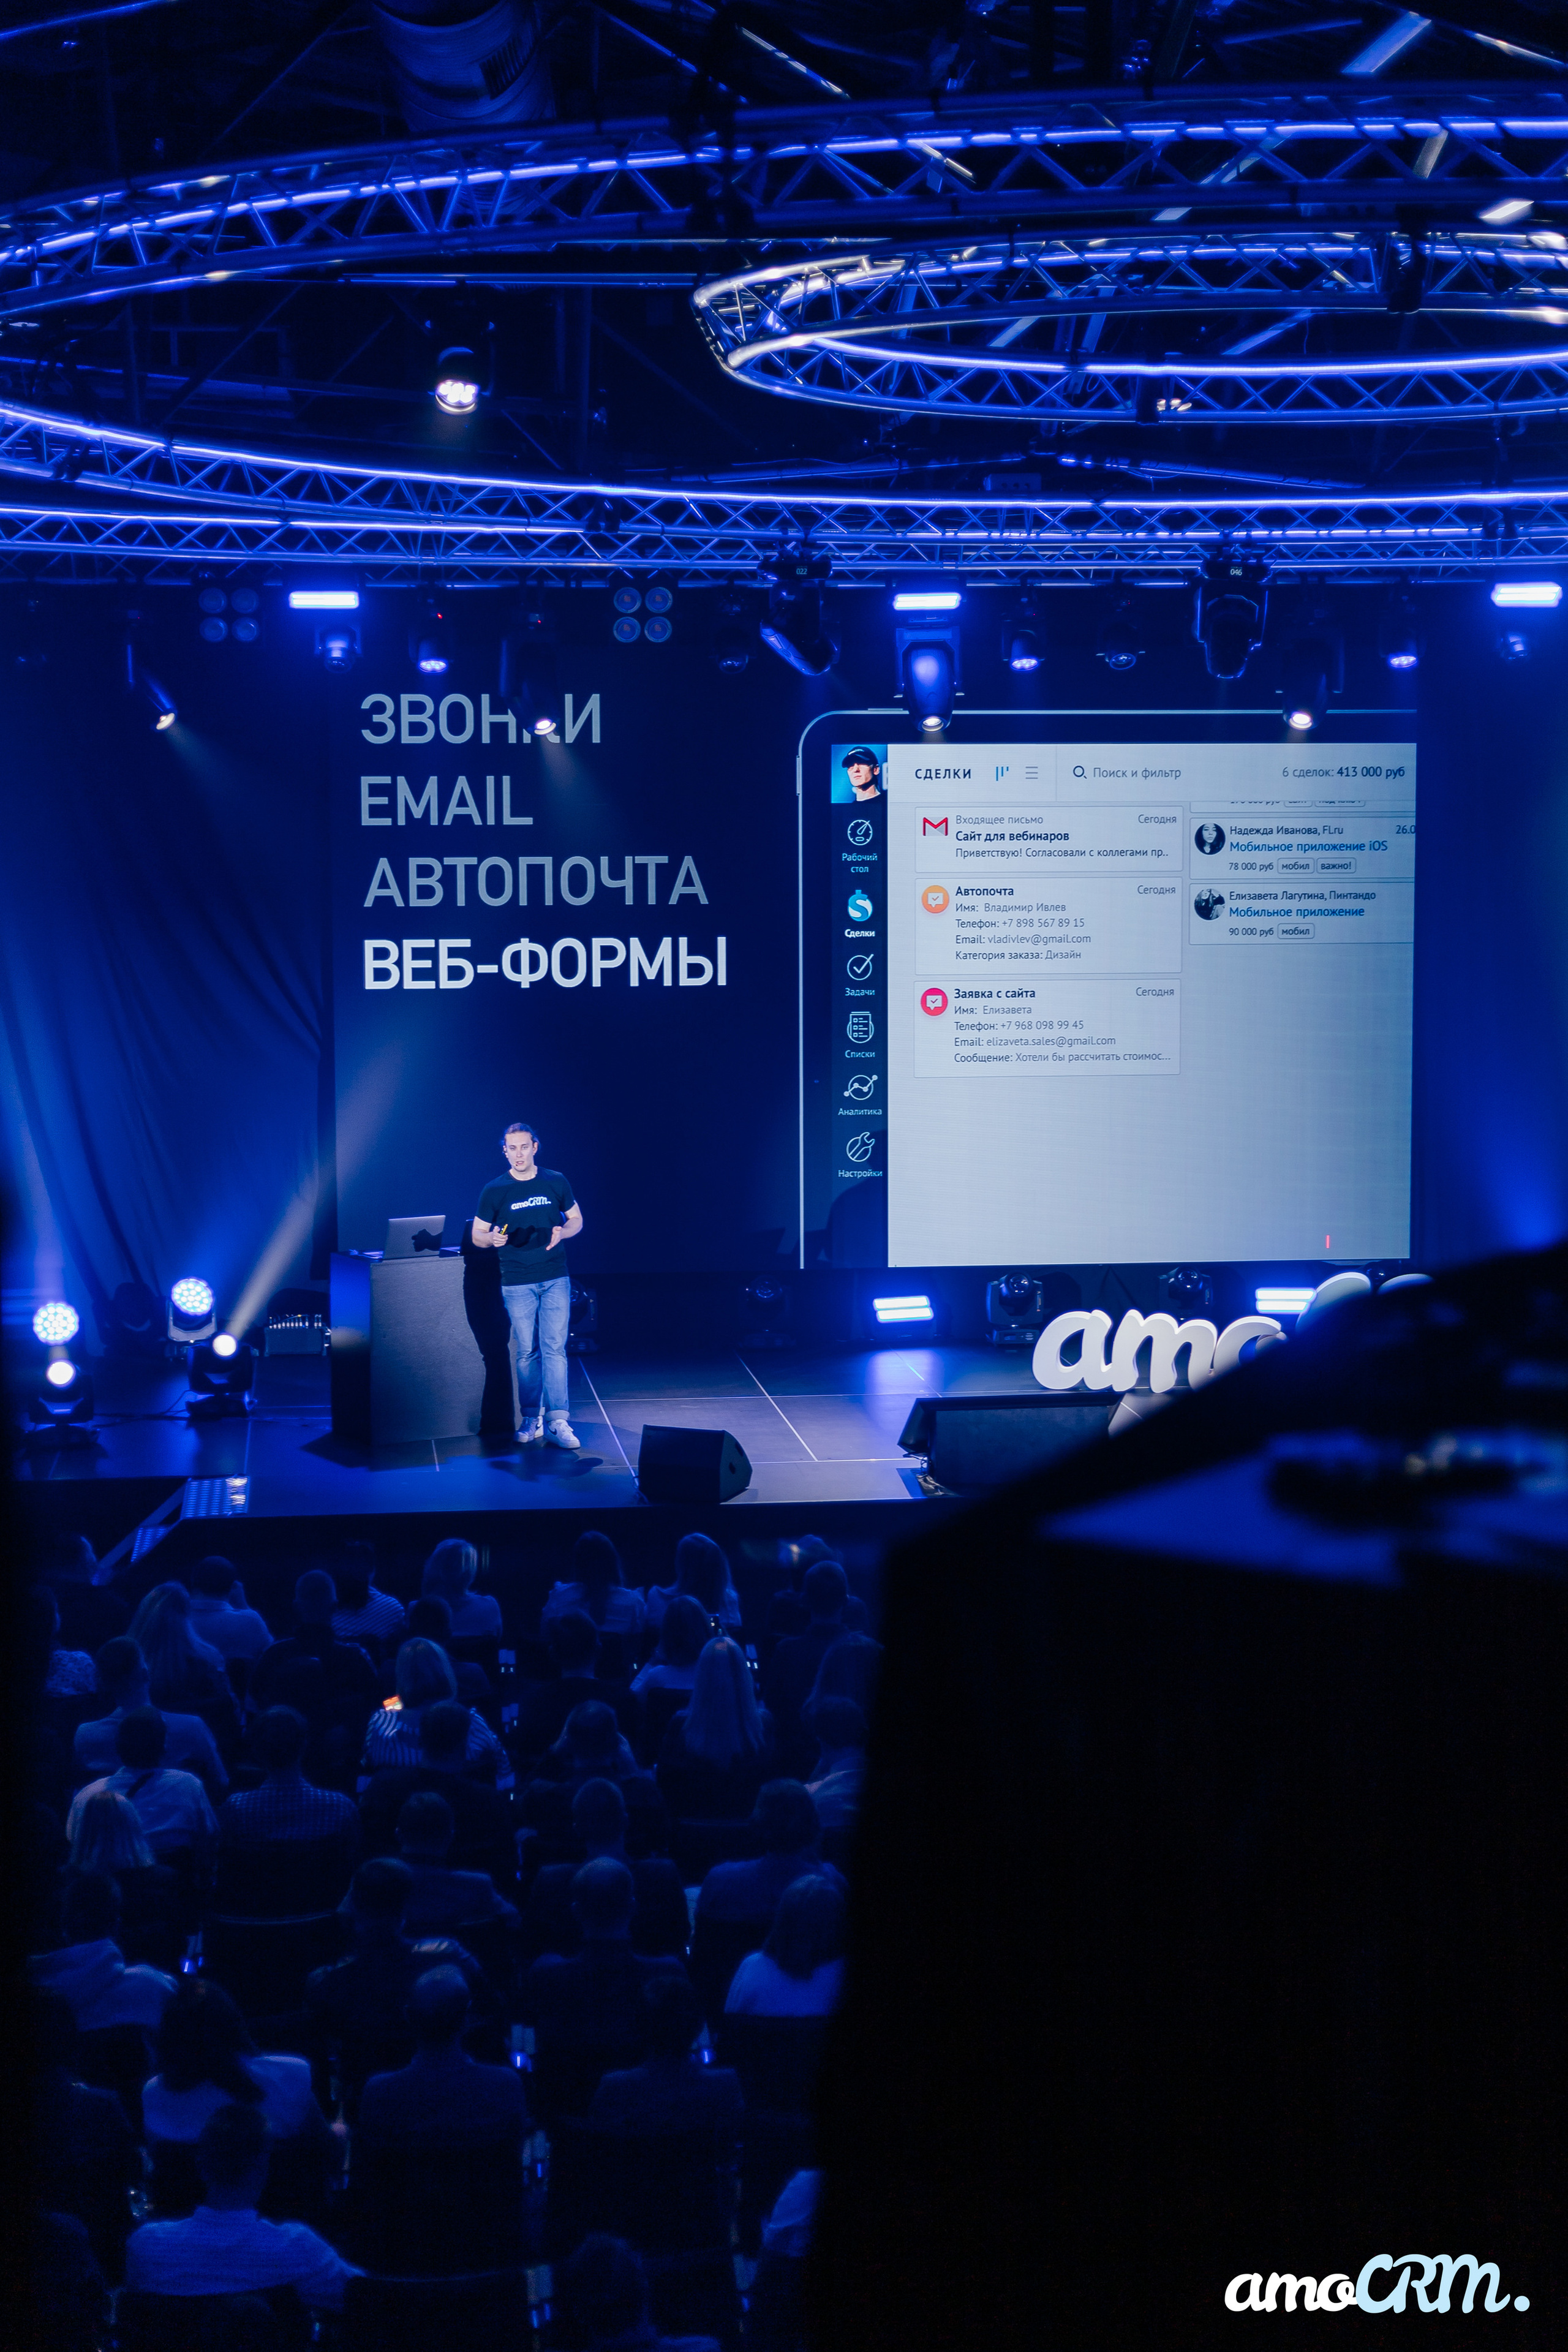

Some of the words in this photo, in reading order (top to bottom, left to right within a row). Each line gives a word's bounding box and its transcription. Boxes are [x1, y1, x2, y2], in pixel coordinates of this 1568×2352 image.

[360, 693, 601, 744] ЗВОНИ
[915, 768, 971, 781] СДЕЛКИ
[1093, 767, 1128, 778] Поиск
[1141, 767, 1182, 780] фильтр
[1282, 766, 1289, 777] 6
[1292, 769, 1335, 778] сделок:
[1336, 766, 1358, 777] 413
[1361, 766, 1382, 777] 000
[1385, 766, 1406, 780] руб
[360, 775, 533, 826] EMAIL
[956, 815, 1005, 825] Входящее
[1138, 814, 1177, 824] Сегодня
[956, 831, 982, 842] Сайт
[984, 833, 1005, 842] для
[1009, 830, 1069, 843] вебинаров
[1230, 826, 1273, 836] Надежда
[1276, 826, 1321, 836] Иванова,
[1230, 841, 1294, 852] Мобильное
[1297, 843, 1366, 854] приложение
[1369, 840, 1388, 851] iOS
[842, 853, 878, 861] Рабочий
[956, 848, 1022, 859] Приветствую!
[1025, 848, 1086, 858] Согласовали
[1229, 862, 1239, 870] 78
[1241, 862, 1257, 870] 000
[1259, 862, 1274, 872] руб
[1281, 861, 1310, 870] мобил
[1321, 861, 1352, 870] важно!
[363, 856, 709, 907] АВТОПОЧТА
[955, 886, 1014, 896] Автопочта
[1137, 884, 1176, 895] Сегодня
[1229, 891, 1278, 900] Елизавета
[1280, 891, 1327, 902] Лагутина,
[1329, 890, 1376, 901] Пинтандо
[956, 903, 979, 912] Имя:
[984, 902, 1033, 914] Владимир
[1036, 903, 1066, 912] Ивлев
[1229, 907, 1293, 918] Мобильное
[1296, 908, 1365, 919] приложение
[955, 919, 1000, 930] Телефон:
[1001, 918, 1014, 928] +7
[1016, 918, 1035, 928] 898
[1038, 918, 1055, 928] 567
[1058, 918, 1070, 928] 89
[1073, 918, 1085, 927] 15
[844, 929, 875, 938] Сделки
[1229, 927, 1240, 936] 90
[1241, 927, 1257, 936] 000
[1259, 927, 1274, 937] руб
[1281, 926, 1310, 935] мобил
[956, 935, 986, 944] Email:
[987, 933, 1091, 946] vladivlev@gmail.com
[956, 951, 1005, 962] Категория
[1044, 950, 1082, 960] Дизайн
[364, 937, 727, 990] ВЕБ-ФОРМЫ
[845, 987, 875, 997] Задачи
[954, 988, 993, 999] Заявка
[1005, 988, 1036, 998] сайта
[1136, 987, 1175, 997] Сегодня
[954, 1006, 978, 1015] Имя:
[983, 1005, 1032, 1015] Елизавета
[954, 1021, 998, 1033] Телефон:
[1000, 1020, 1012, 1030] +7
[1014, 1020, 1033, 1030] 968
[1035, 1020, 1054, 1030] 098
[1057, 1020, 1069, 1030] 99
[1071, 1020, 1084, 1030] 45
[954, 1037, 984, 1047] Email:
[986, 1036, 1116, 1048] elizaveta.sales@gmail.com
[845, 1050, 875, 1058] Списки
[954, 1053, 1013, 1063] Сообщение:
[1015, 1052, 1049, 1062] Хотели
[1052, 1052, 1065, 1061] бы
[1068, 1054, 1121, 1063] рассчитать
[838, 1169, 883, 1179] Настройки
